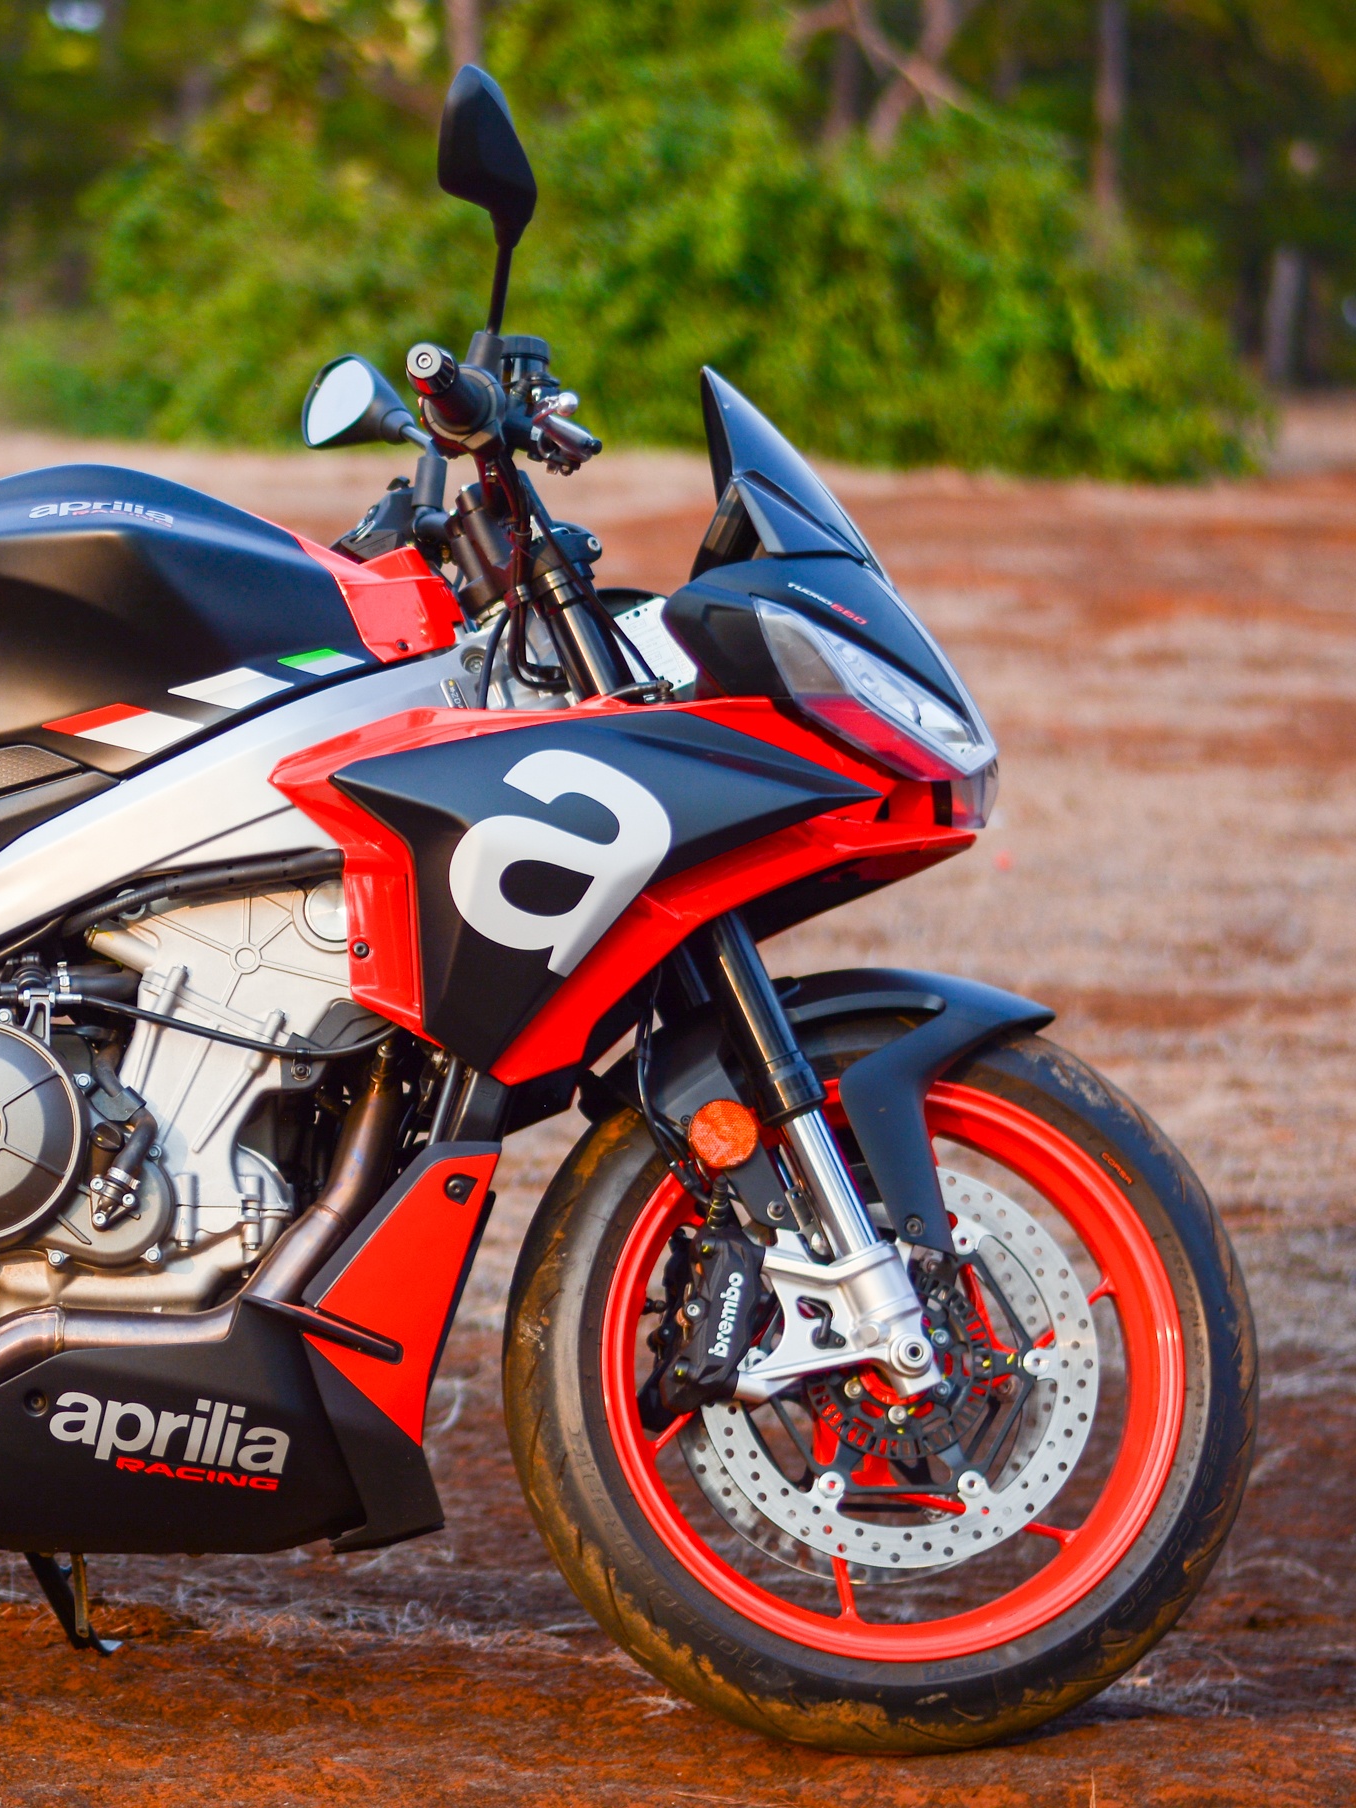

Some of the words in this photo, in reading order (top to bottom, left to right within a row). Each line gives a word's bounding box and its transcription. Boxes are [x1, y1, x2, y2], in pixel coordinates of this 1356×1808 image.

[28, 501, 174, 525] aprilia
[72, 510, 173, 529] RACING
[788, 582, 833, 605] TUONO
[830, 603, 867, 625] 660
[449, 749, 672, 979] a
[1101, 1151, 1132, 1185] CORSA
[708, 1271, 744, 1358] brembo
[49, 1391, 290, 1475] aprilia
[115, 1456, 279, 1491] RACING
